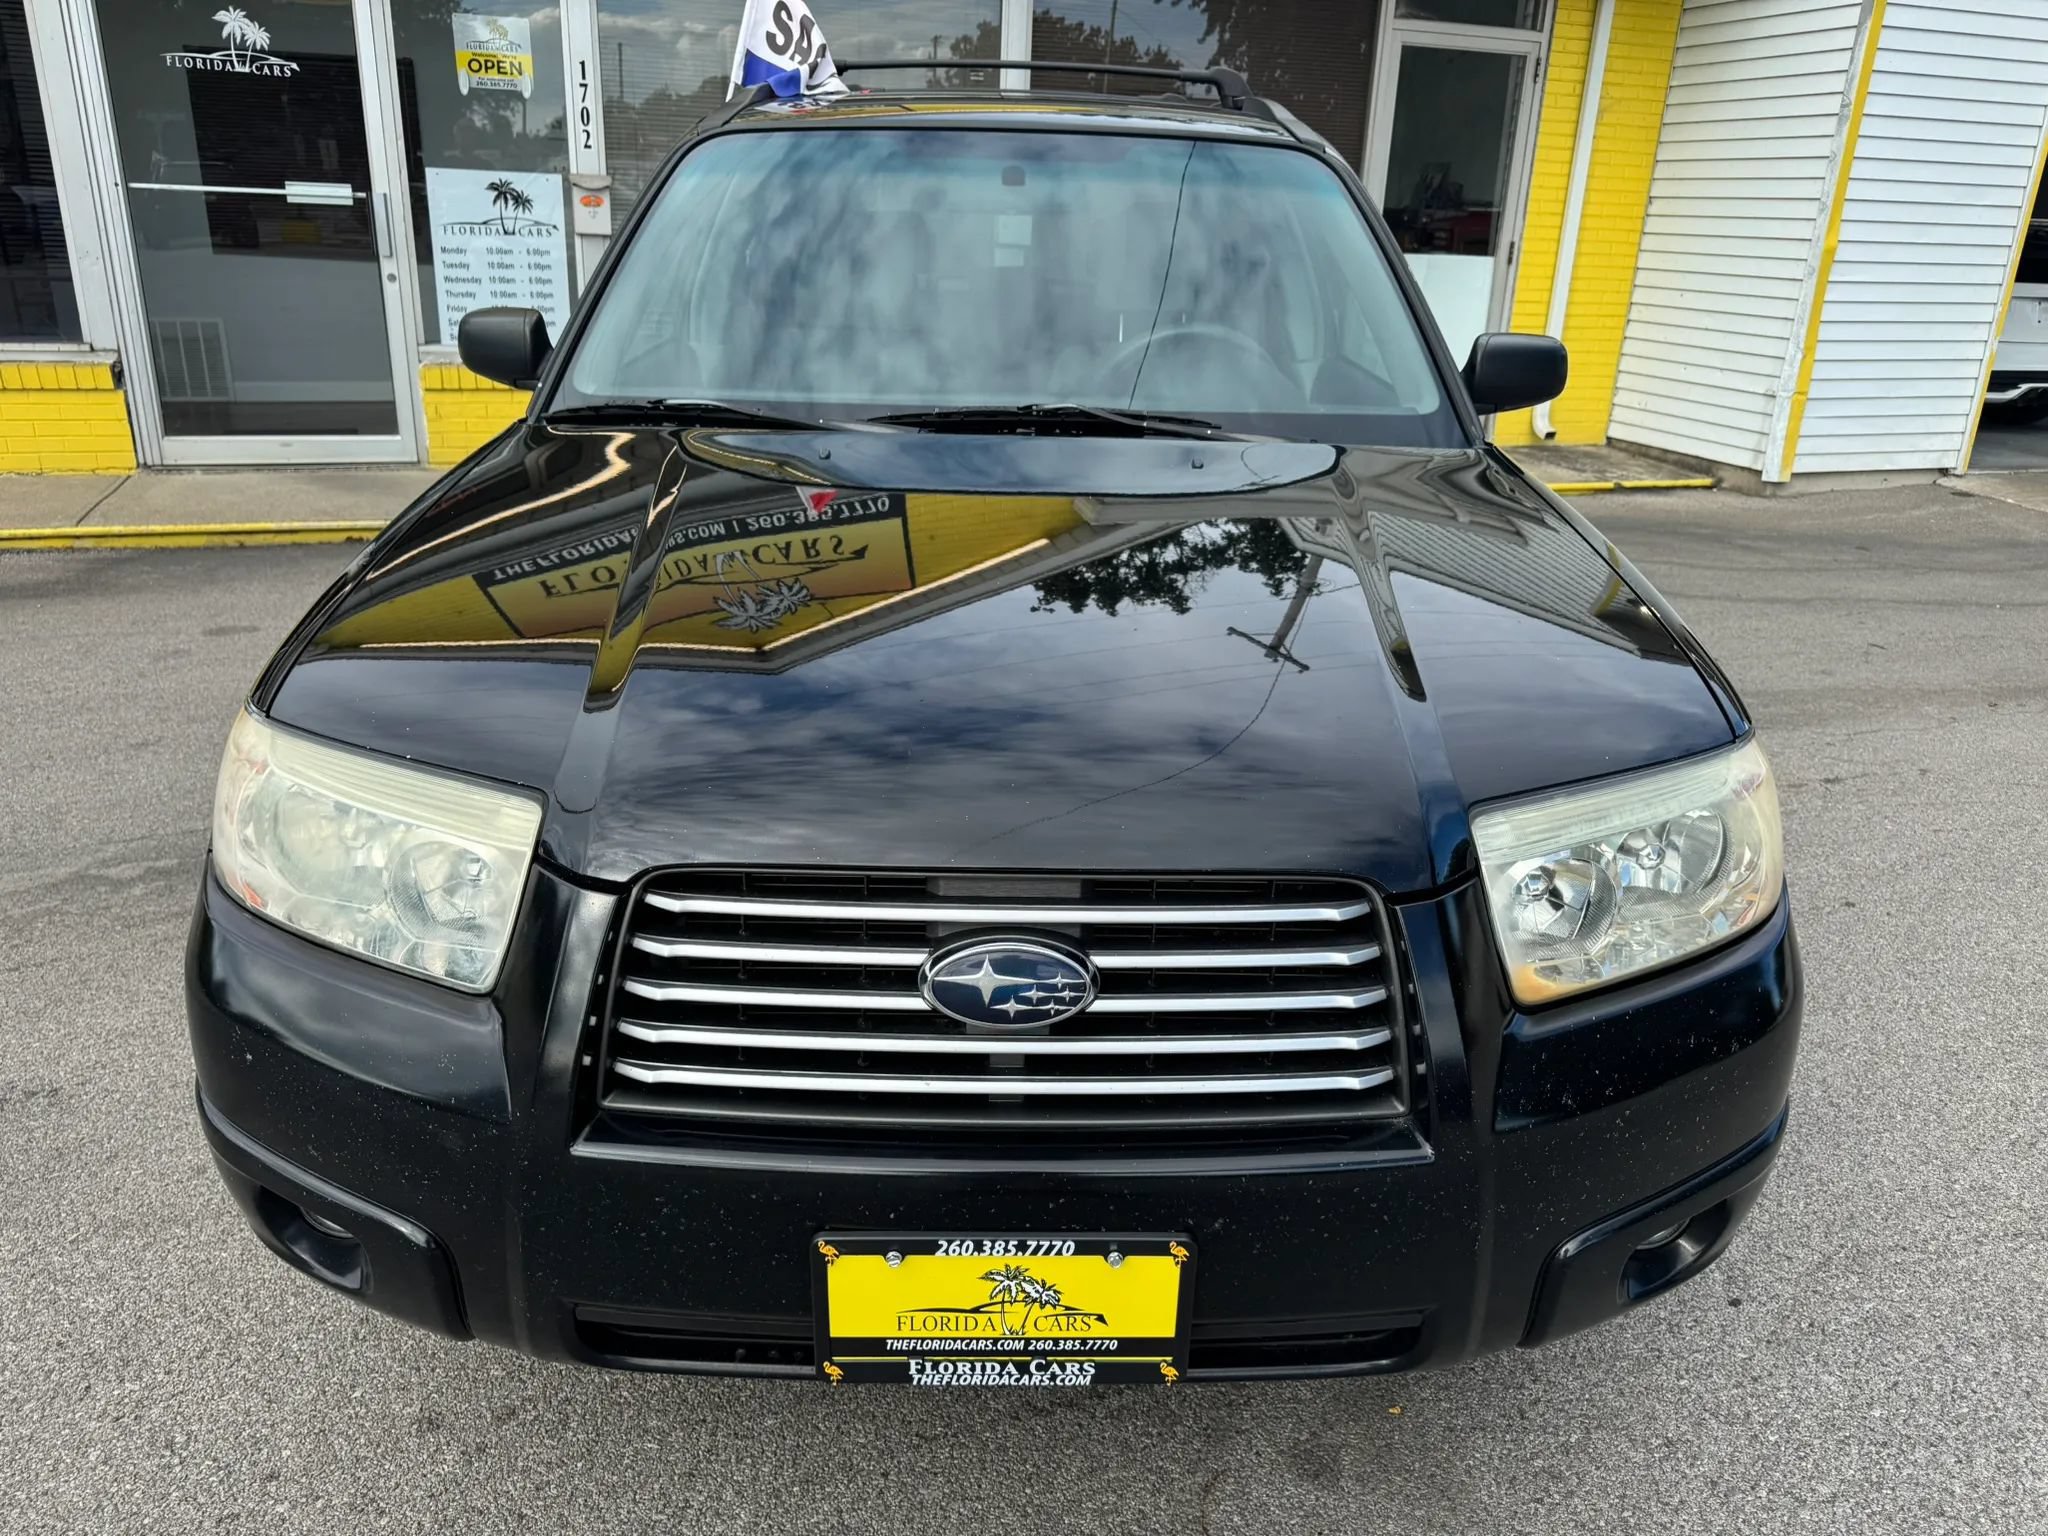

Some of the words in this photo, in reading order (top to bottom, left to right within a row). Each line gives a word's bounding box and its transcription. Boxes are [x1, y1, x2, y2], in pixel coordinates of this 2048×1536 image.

[166, 56, 233, 72] FLORIDA
[252, 62, 292, 77] CARS
[467, 58, 523, 76] OPEN
[578, 60, 592, 149] 1702
[443, 225, 501, 236] FLORIDA
[518, 227, 552, 237] CARS
[440, 246, 467, 257] Monday
[442, 261, 470, 271] Tuesday
[444, 276, 482, 287] Wednesday
[445, 290, 476, 300] Thursday
[447, 304, 467, 314] Friday
[934, 1240, 1076, 1256] 260.385.7770
[897, 1315, 997, 1331] FLORIDA
[1033, 1315, 1092, 1332] CARS
[885, 1339, 1025, 1351] THEFLORIDACARS.COM
[1027, 1339, 1119, 1351] 260.385.7770
[908, 1359, 1019, 1375] FLORIDA
[1029, 1359, 1096, 1375] CARS
[911, 1374, 1092, 1386] THEFLORIDACARS.COM
